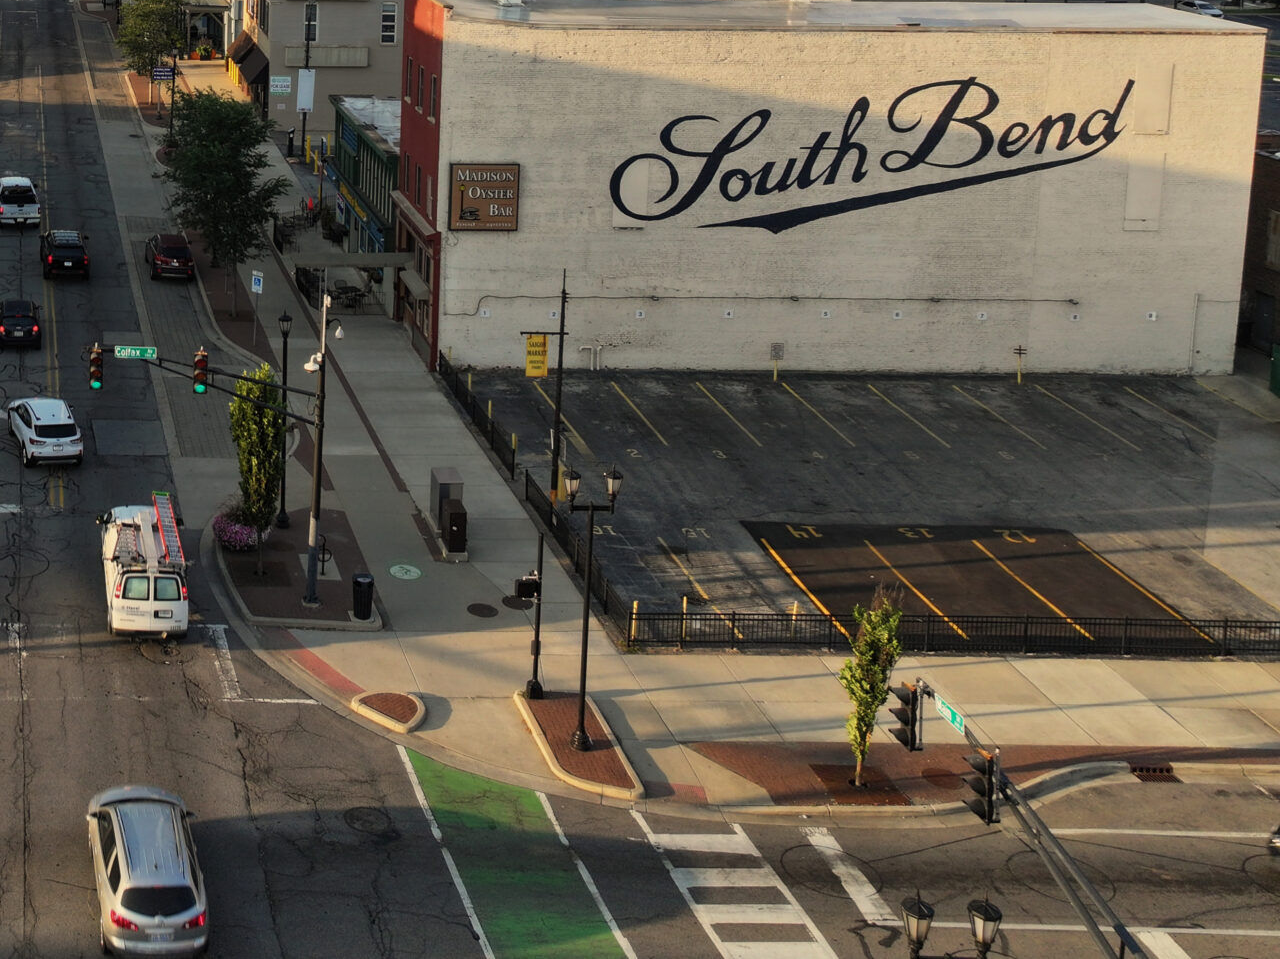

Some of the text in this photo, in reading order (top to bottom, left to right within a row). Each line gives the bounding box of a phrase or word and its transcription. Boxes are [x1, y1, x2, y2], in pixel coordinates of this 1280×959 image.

[610, 77, 1136, 221] South Bend
[457, 169, 515, 181] MADISON
[469, 186, 514, 199] OYSTER
[490, 204, 513, 216] BAR
[116, 347, 141, 357] Colfax
[626, 448, 643, 458] 2
[785, 524, 824, 539] 14
[897, 527, 934, 539] 13
[992, 529, 1037, 543] 12
[935, 698, 952, 721] Main
